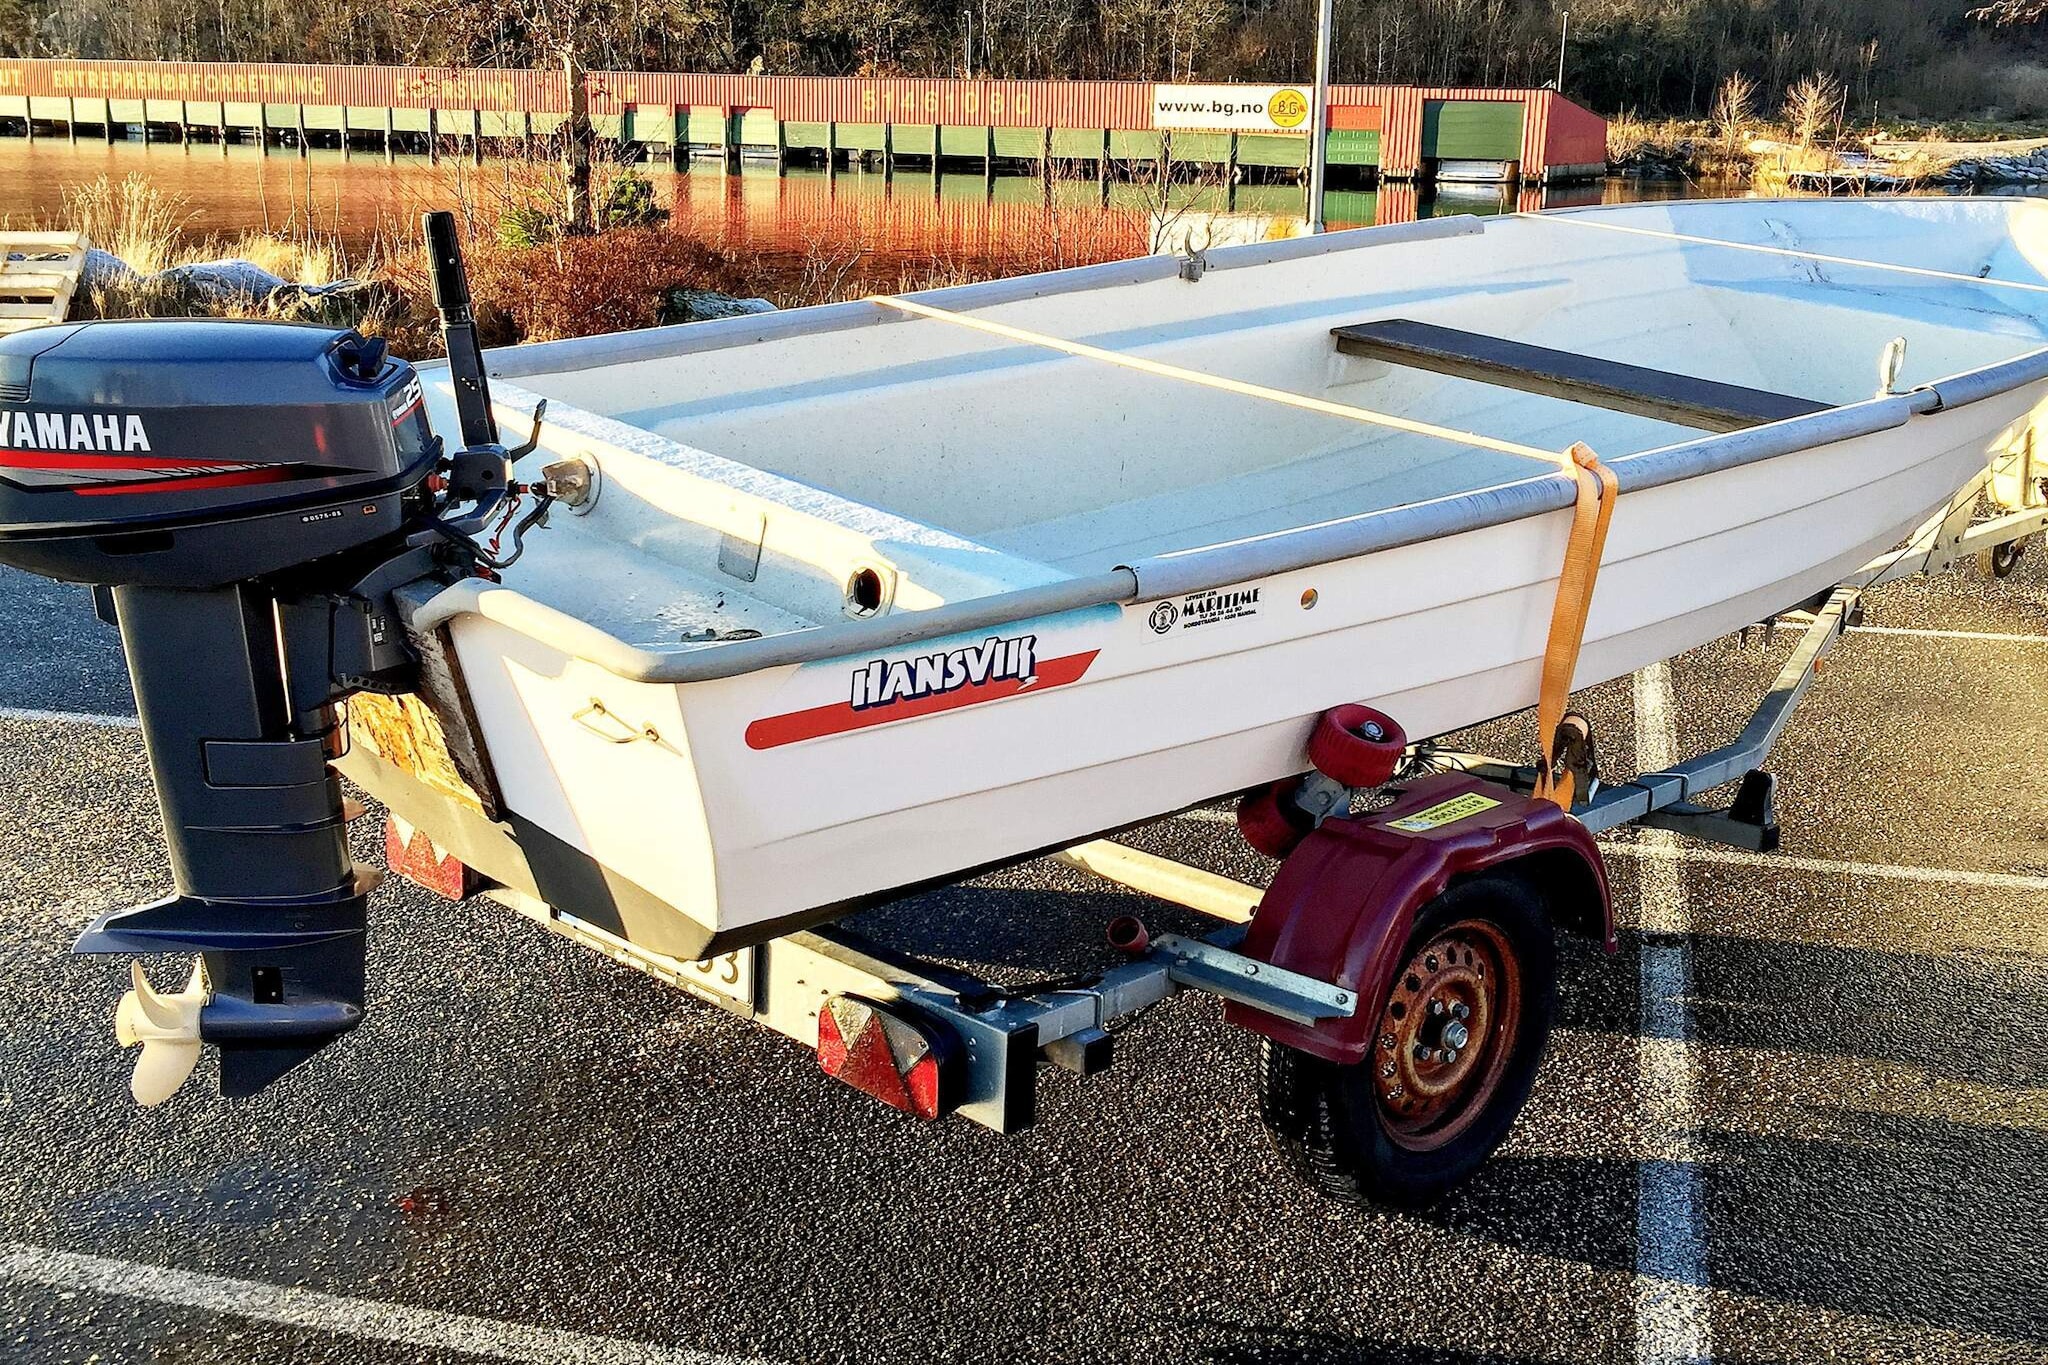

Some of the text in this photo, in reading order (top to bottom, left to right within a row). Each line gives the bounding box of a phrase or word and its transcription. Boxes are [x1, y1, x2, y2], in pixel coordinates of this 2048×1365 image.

[1158, 100, 1263, 116] www.bg.no
[402, 375, 422, 408] 25
[0, 410, 152, 452] YAMAHA
[1180, 587, 1261, 617] MARITIME
[850, 634, 1038, 712] HANSVIK
